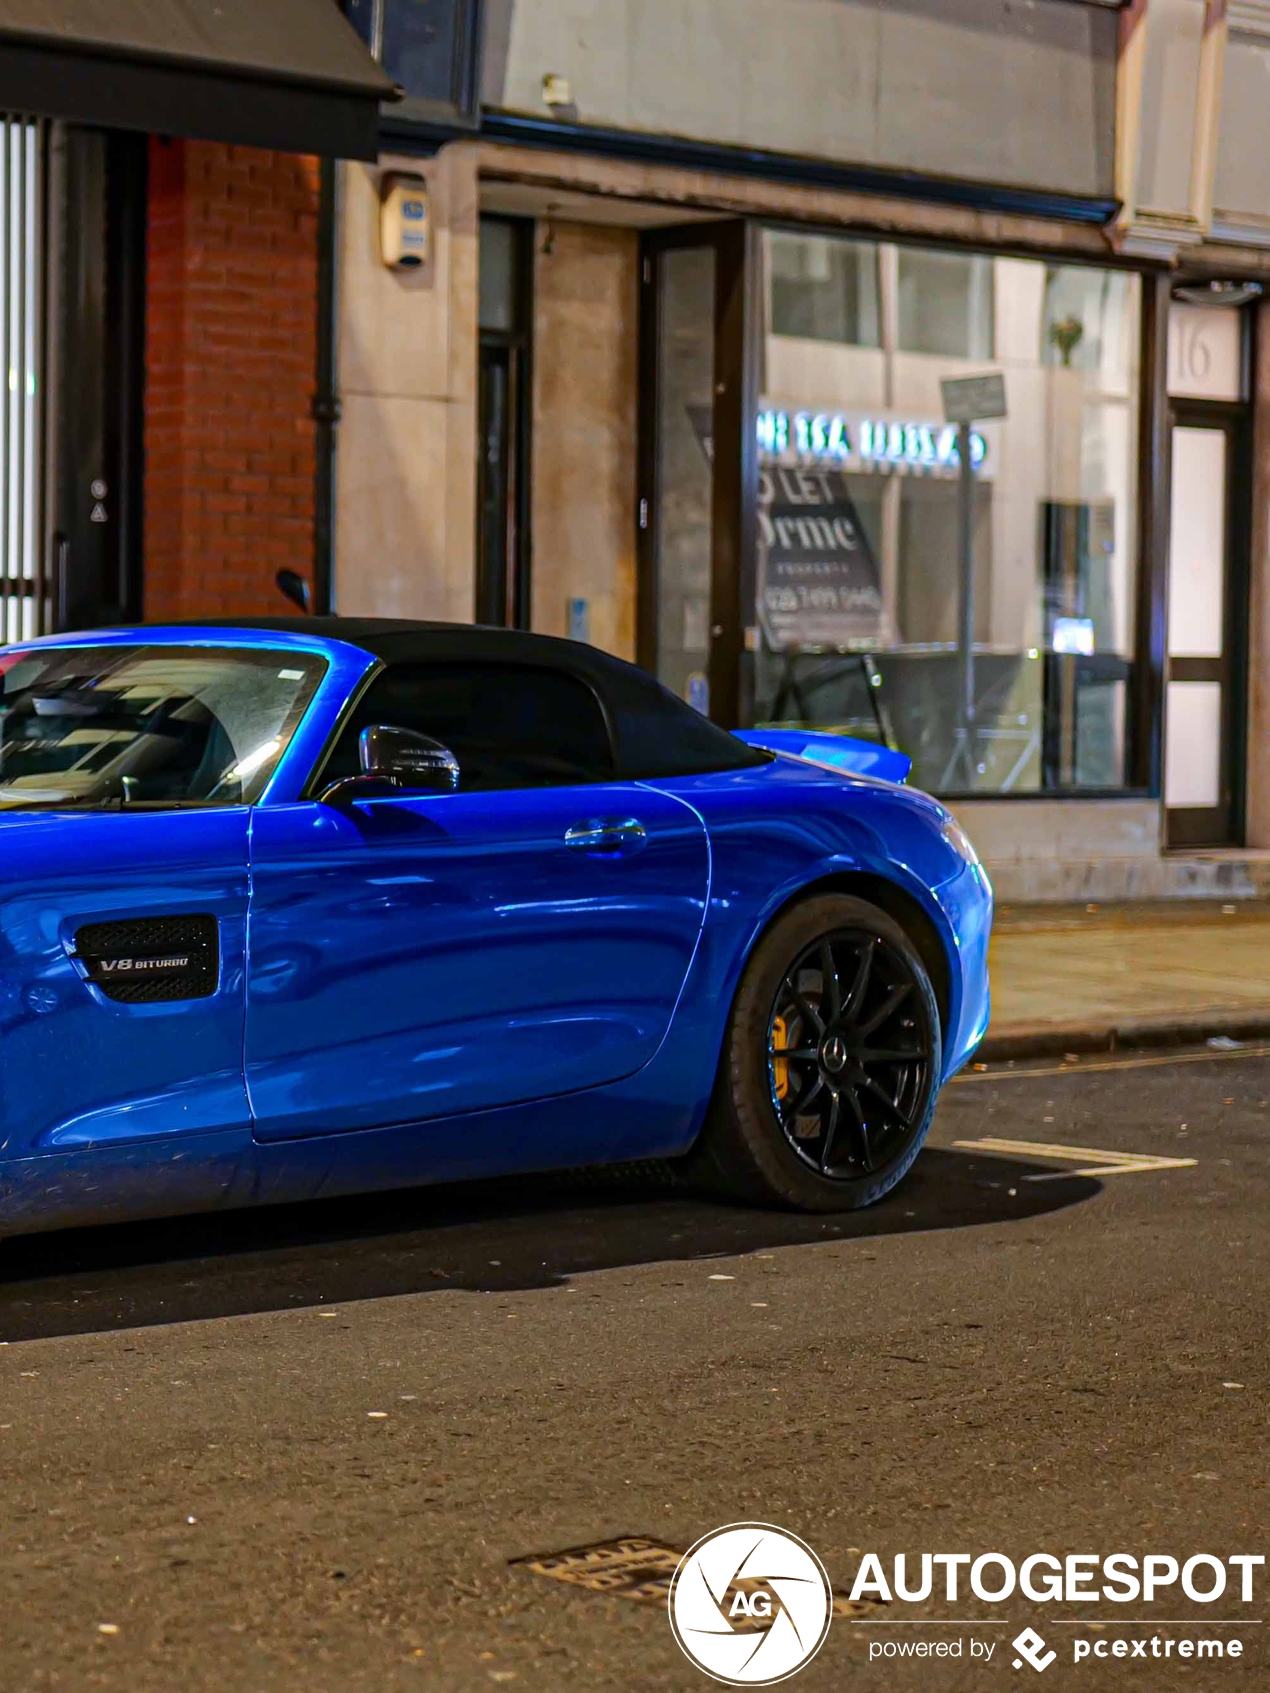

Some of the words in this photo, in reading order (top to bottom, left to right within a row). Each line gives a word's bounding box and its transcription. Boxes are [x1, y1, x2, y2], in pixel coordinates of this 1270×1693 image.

[1176, 318, 1211, 382] 16
[780, 472, 835, 505] LET
[101, 959, 132, 972] V8
[135, 958, 189, 969] BITURBO
